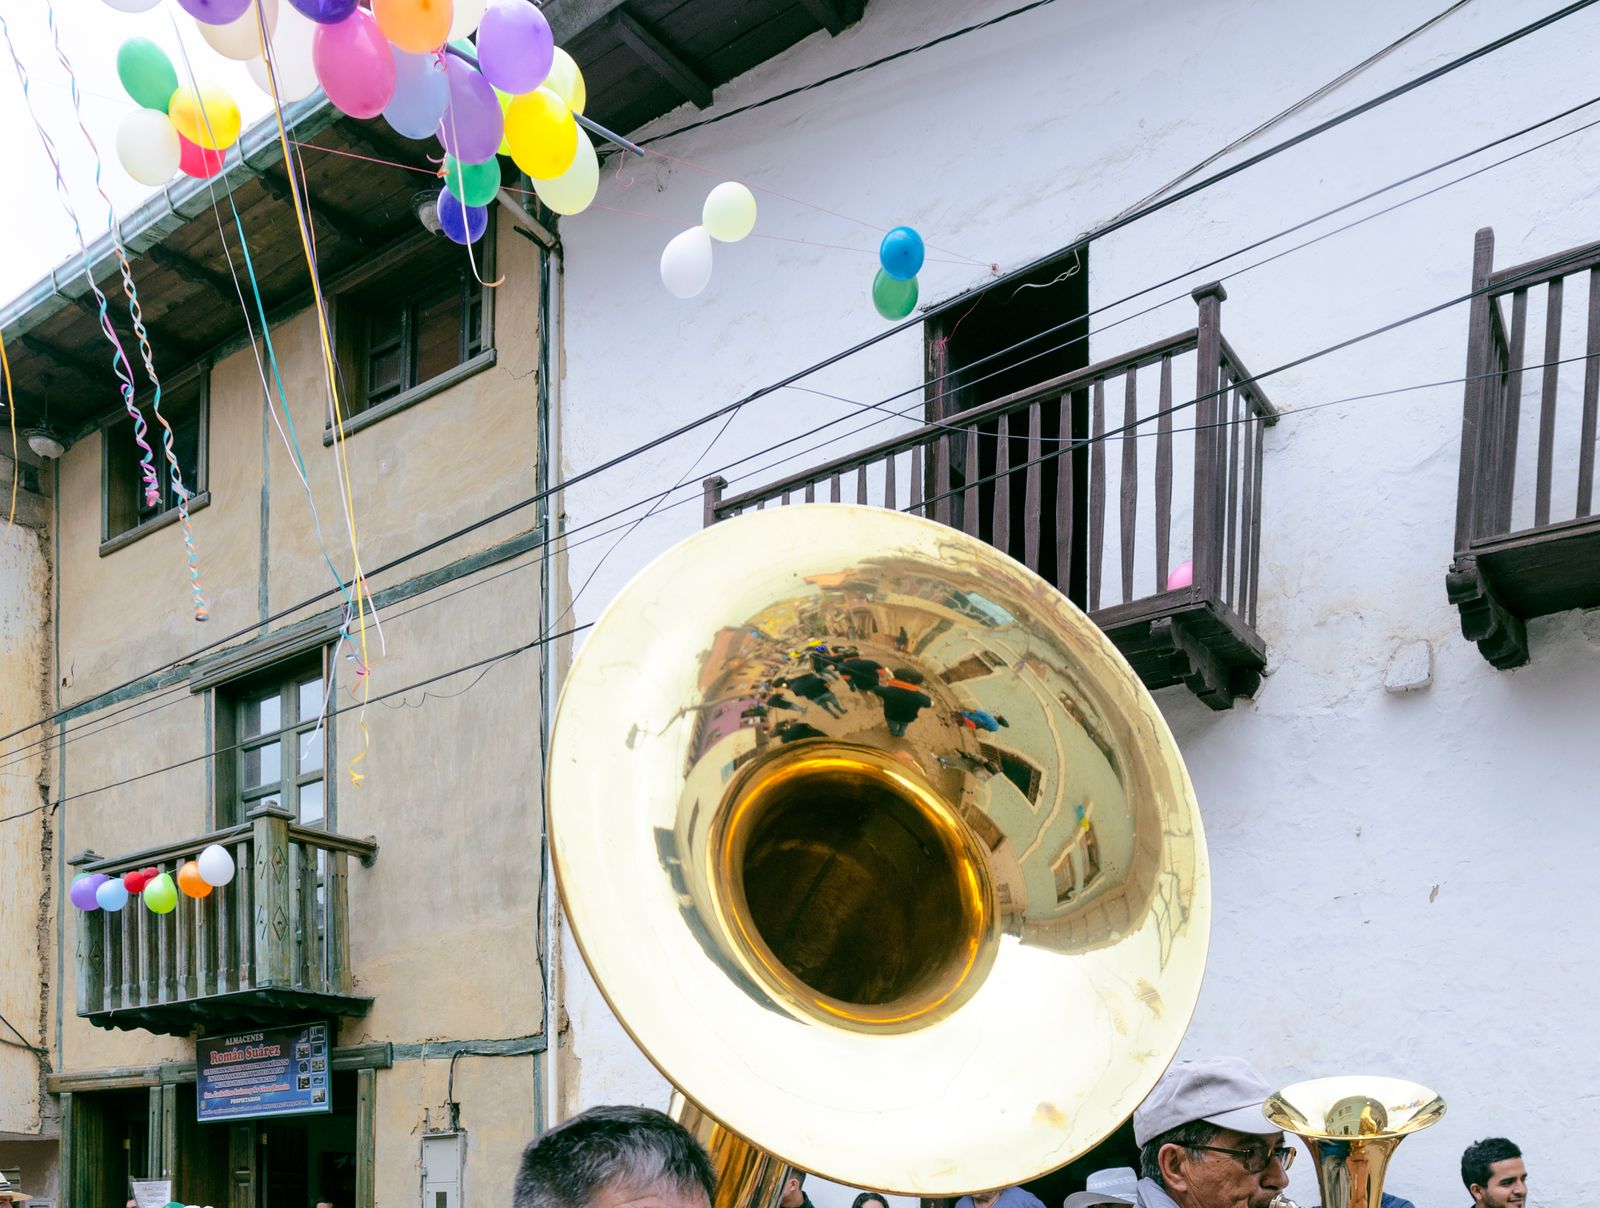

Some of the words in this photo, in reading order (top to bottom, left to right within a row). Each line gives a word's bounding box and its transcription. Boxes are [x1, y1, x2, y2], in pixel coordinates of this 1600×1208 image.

[225, 1033, 264, 1046] ALMACENES
[210, 1047, 244, 1064] Román
[245, 1043, 281, 1059] Suárez
